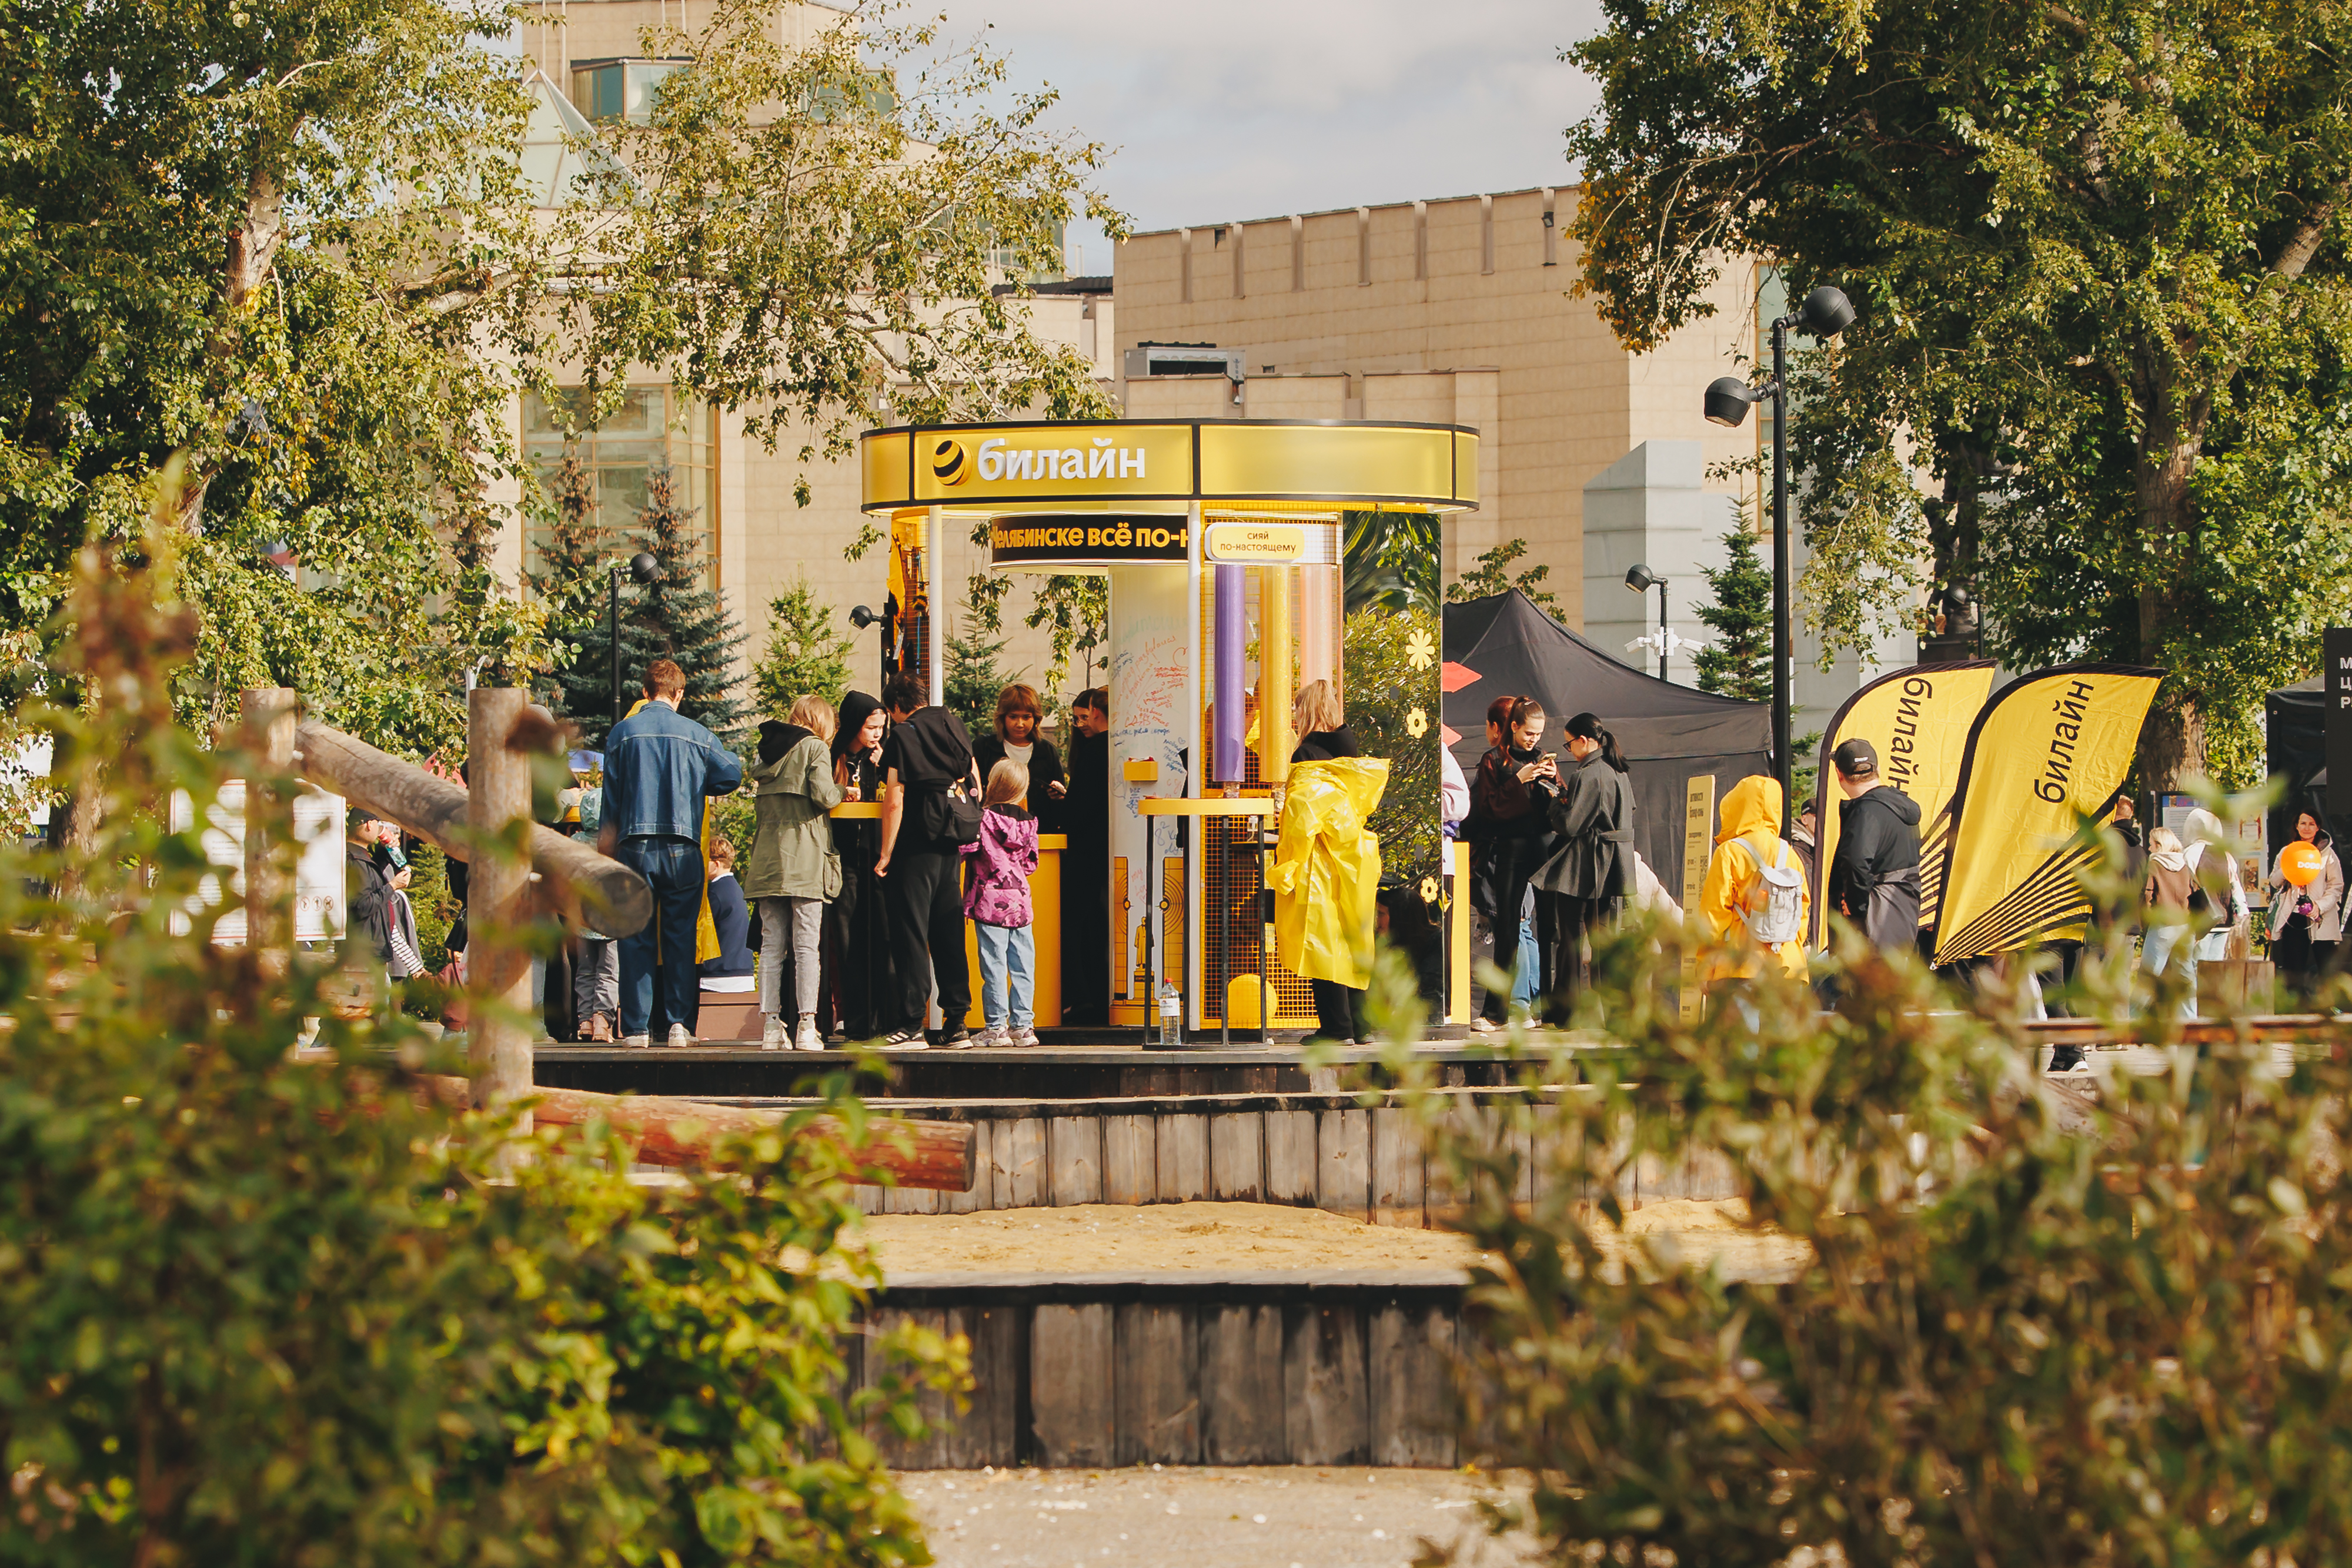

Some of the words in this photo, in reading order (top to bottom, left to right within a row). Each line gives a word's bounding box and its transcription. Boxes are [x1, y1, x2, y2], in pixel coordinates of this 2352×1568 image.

[977, 437, 1145, 481] билайн
[1087, 522, 1132, 547] всё
[1220, 543, 1296, 554] по-настоящему
[1247, 531, 1269, 540] сияй
[1887, 677, 1933, 797] билайн
[2034, 680, 2094, 804] билайн
